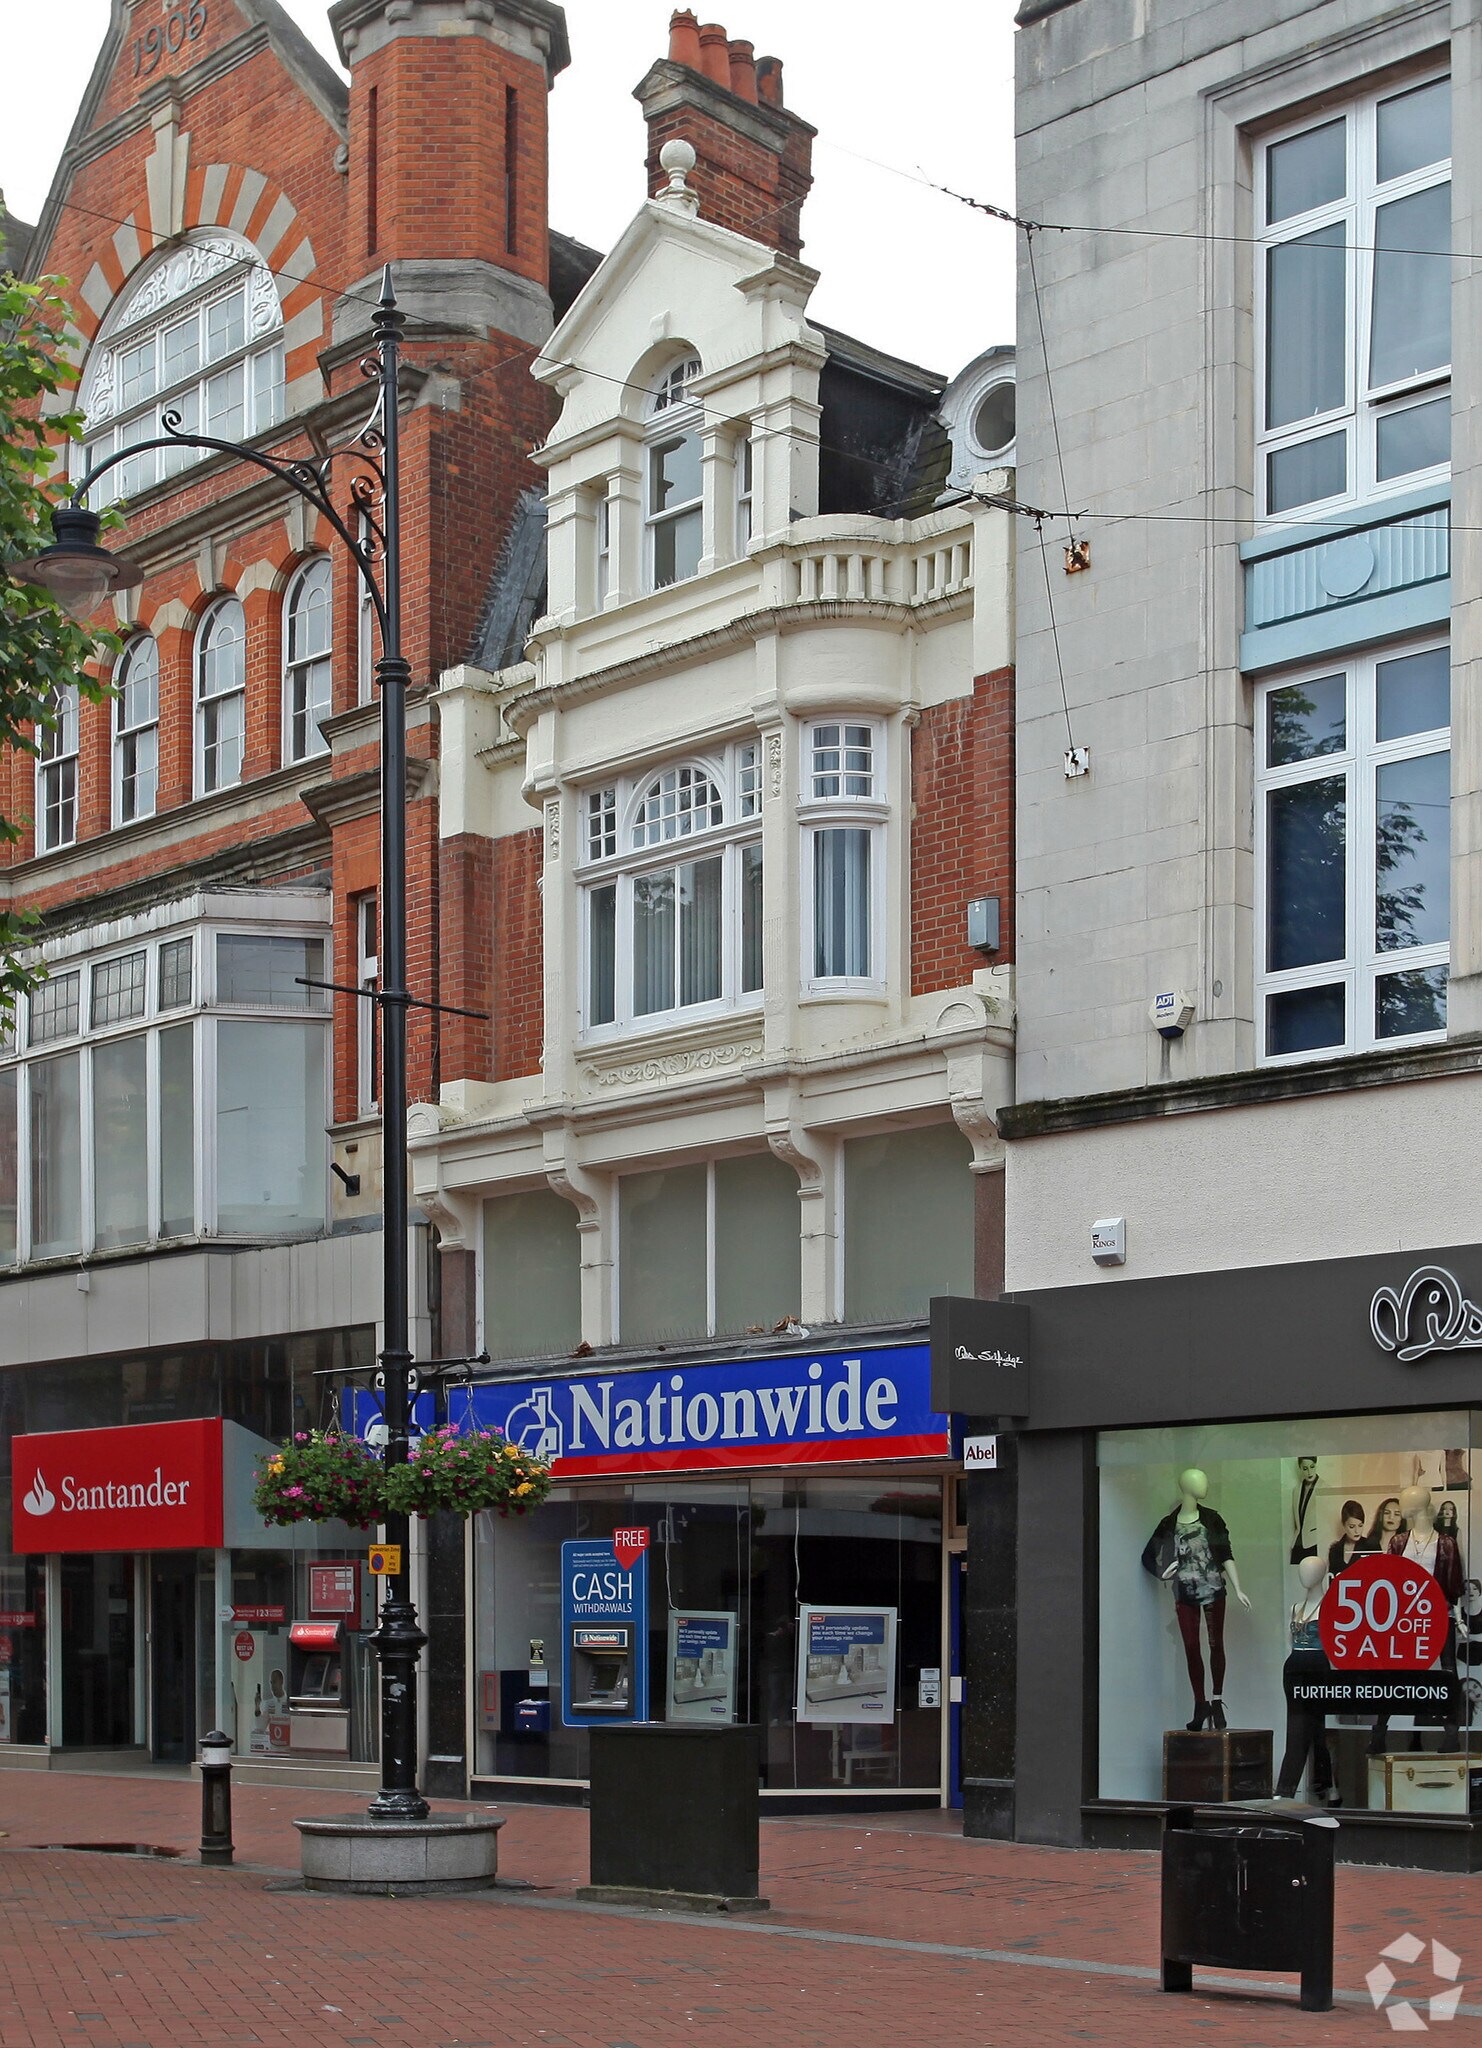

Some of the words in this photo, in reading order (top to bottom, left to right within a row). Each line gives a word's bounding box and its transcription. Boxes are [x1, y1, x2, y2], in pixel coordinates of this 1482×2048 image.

[134, 0, 207, 78] 1905
[1156, 995, 1174, 1007] ADT
[568, 1359, 899, 1450] Nationwide
[965, 1444, 995, 1461] Abel
[61, 1466, 190, 1512] Santander
[615, 1530, 645, 1547] FREE
[572, 1572, 633, 1601] CASH
[573, 1602, 633, 1614] WITHDRAWALS
[1333, 1579, 1432, 1632] 50%
[1397, 1618, 1432, 1633] OFF
[304, 1627, 331, 1636] Santander
[589, 1634, 618, 1643] Nationwide
[1334, 1634, 1430, 1660] SALE
[1293, 1686, 1351, 1699] FURTHER
[1356, 1686, 1449, 1700] REDUCTIONS
